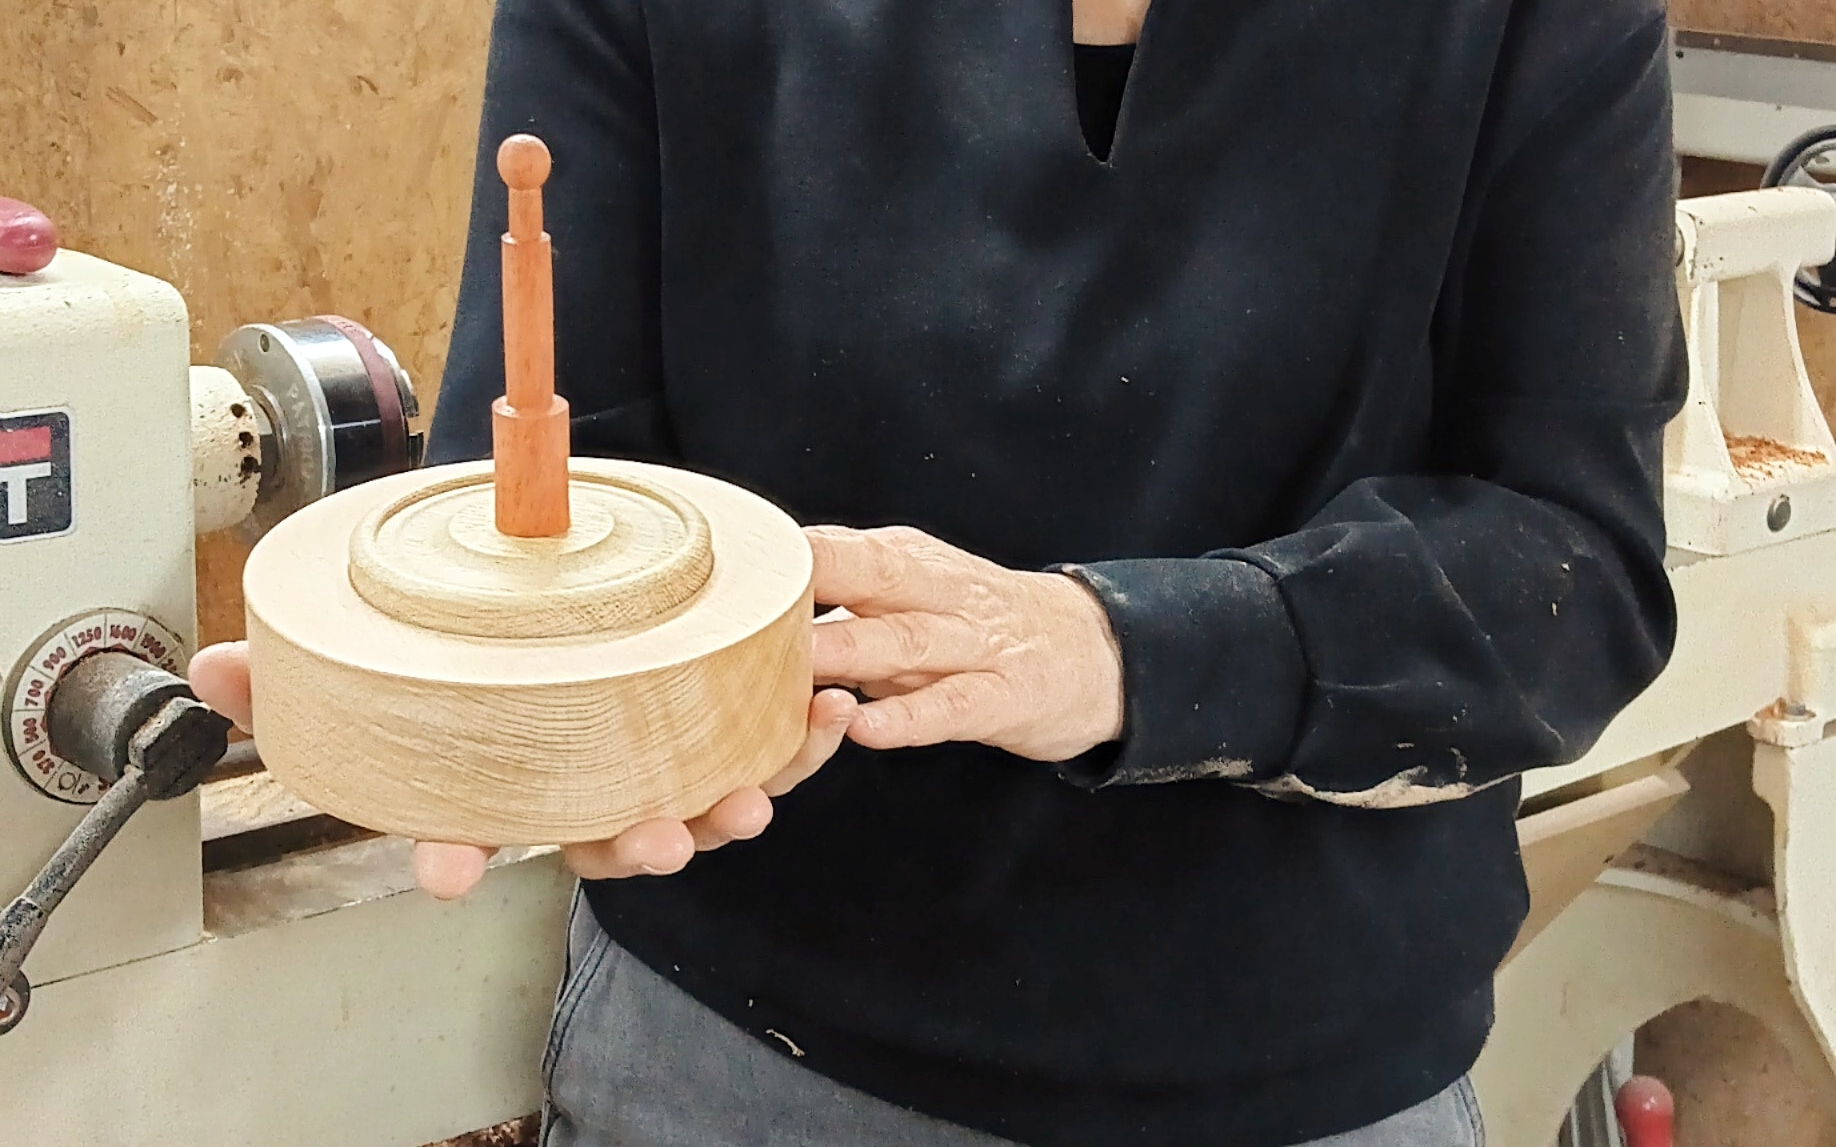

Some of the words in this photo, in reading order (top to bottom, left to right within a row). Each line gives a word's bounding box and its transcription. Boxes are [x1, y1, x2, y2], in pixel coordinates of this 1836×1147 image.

[72, 626, 102, 648] 1250
[110, 624, 137, 642] 1600
[43, 646, 66, 671] 900
[25, 679, 44, 706] 700
